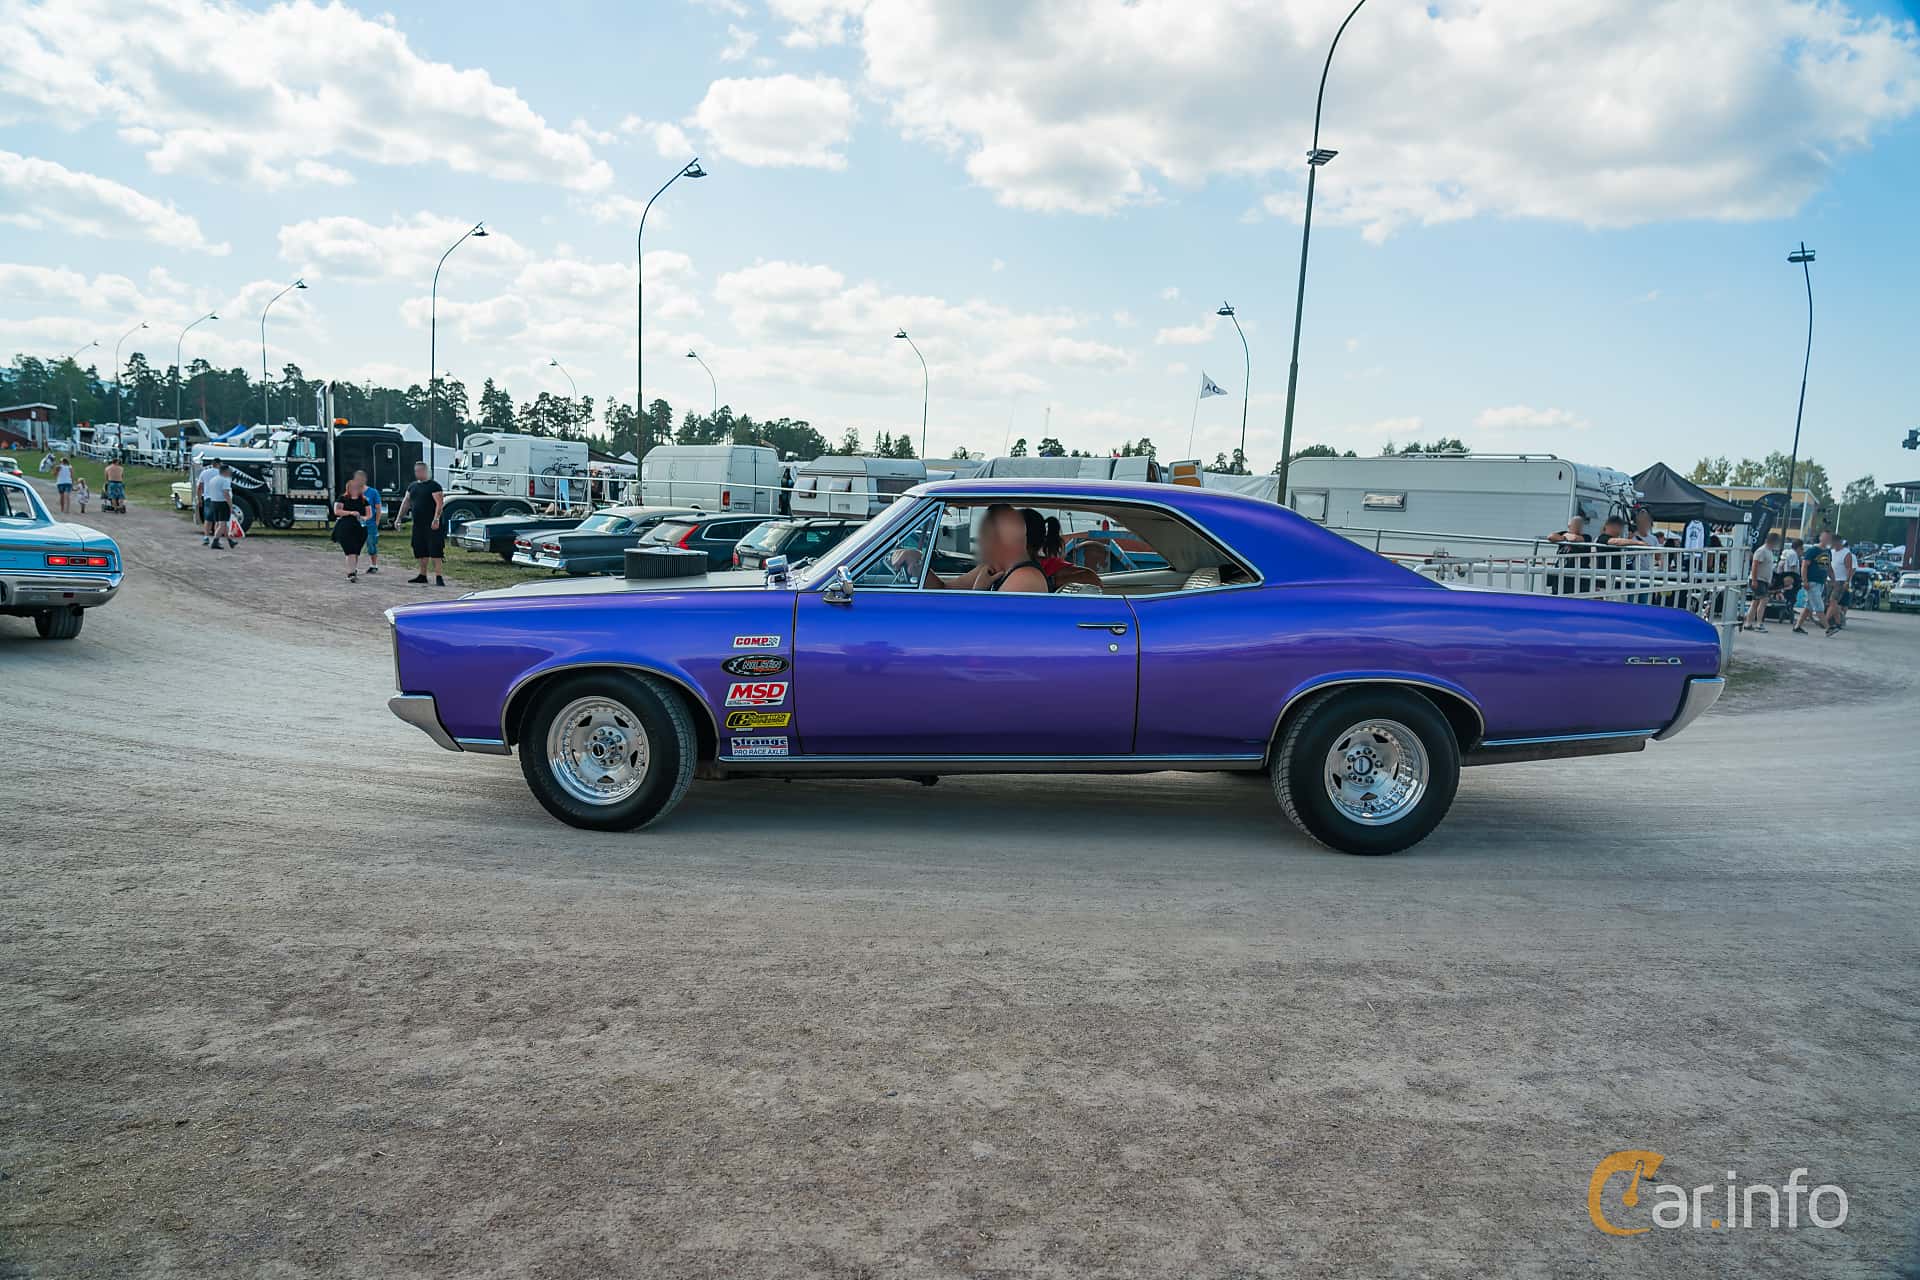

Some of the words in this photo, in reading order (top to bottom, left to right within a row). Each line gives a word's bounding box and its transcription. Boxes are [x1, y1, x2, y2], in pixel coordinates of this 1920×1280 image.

[736, 637, 769, 645] COMP
[1626, 656, 1682, 665] GTO
[730, 683, 785, 699] MSD
[733, 738, 786, 747] Strange
